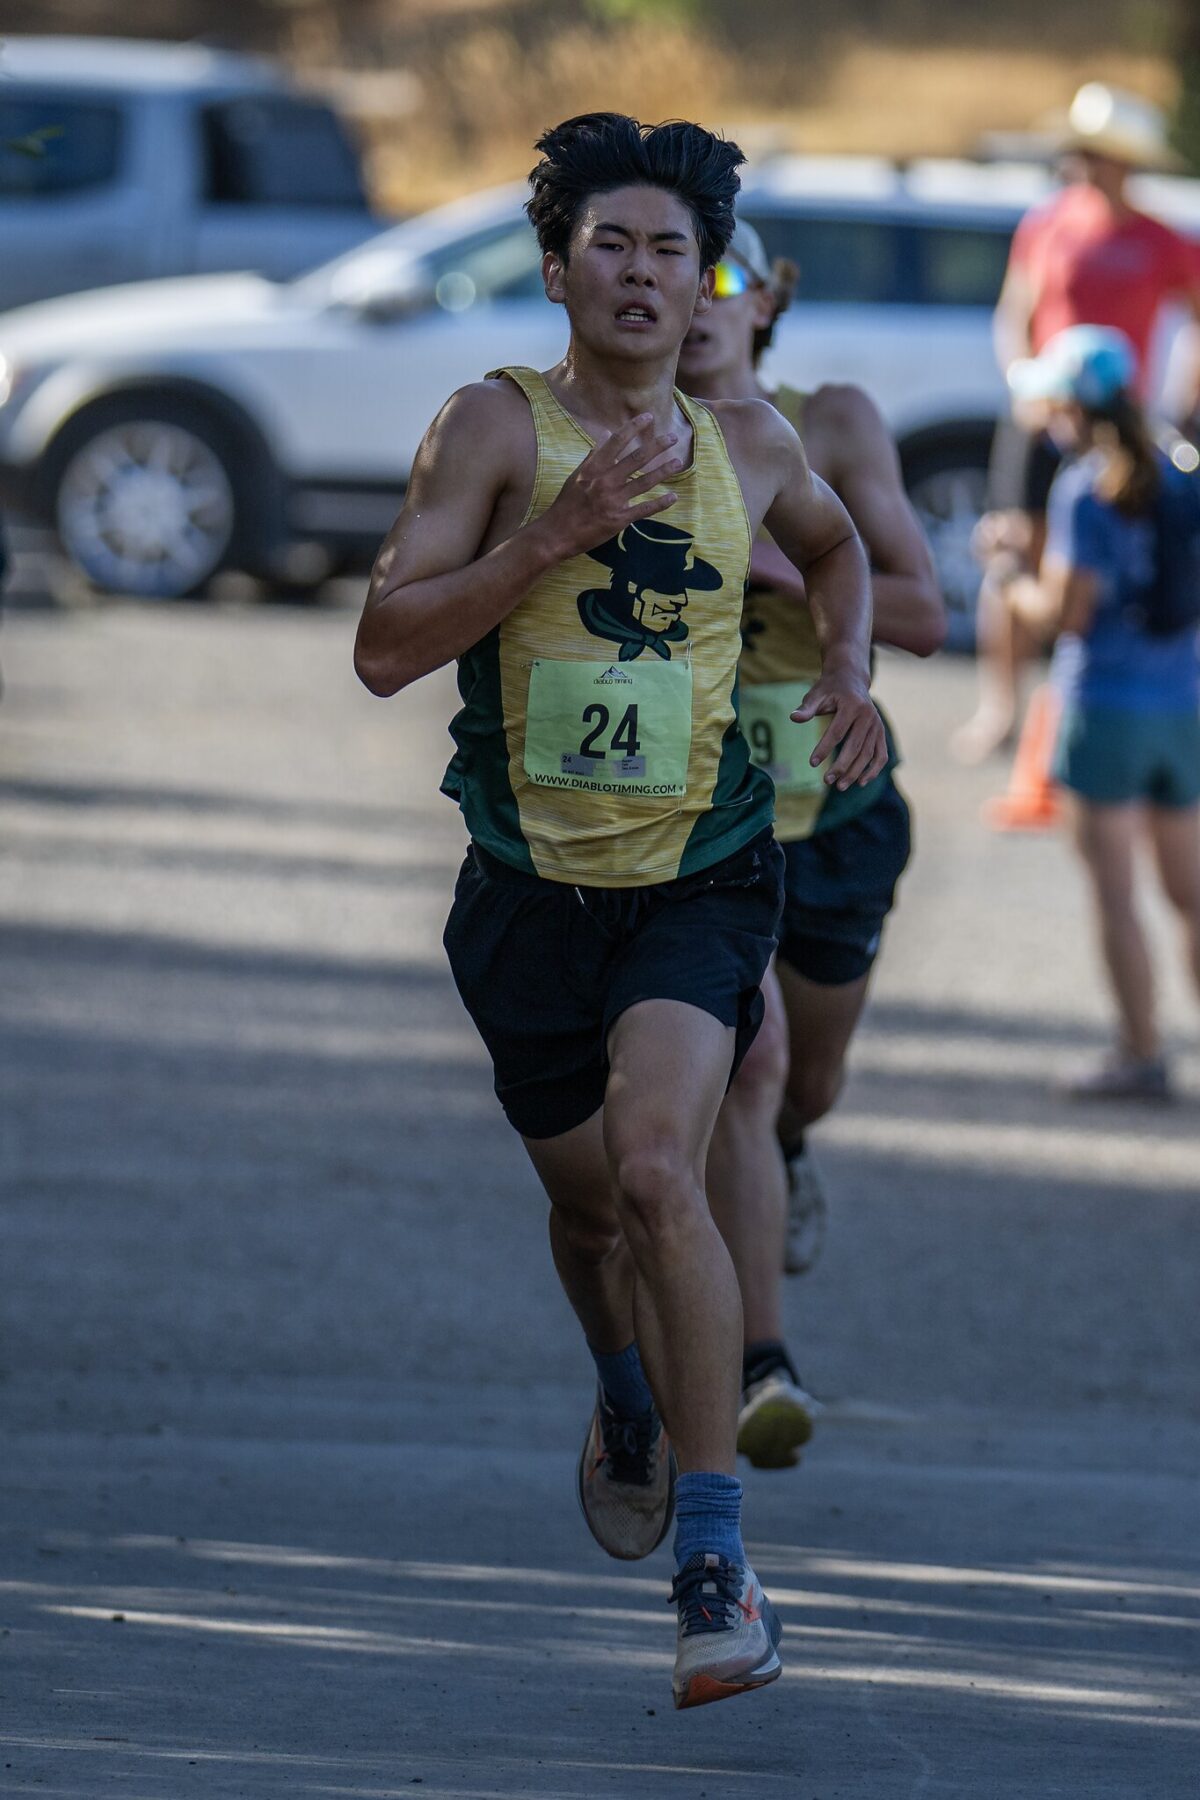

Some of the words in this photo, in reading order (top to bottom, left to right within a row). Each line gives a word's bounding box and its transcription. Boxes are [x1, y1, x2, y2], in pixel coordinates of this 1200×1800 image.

[580, 703, 641, 760] 24
[562, 756, 572, 764] 24
[535, 773, 676, 794] WWW.DIABLOTIMING.COM
